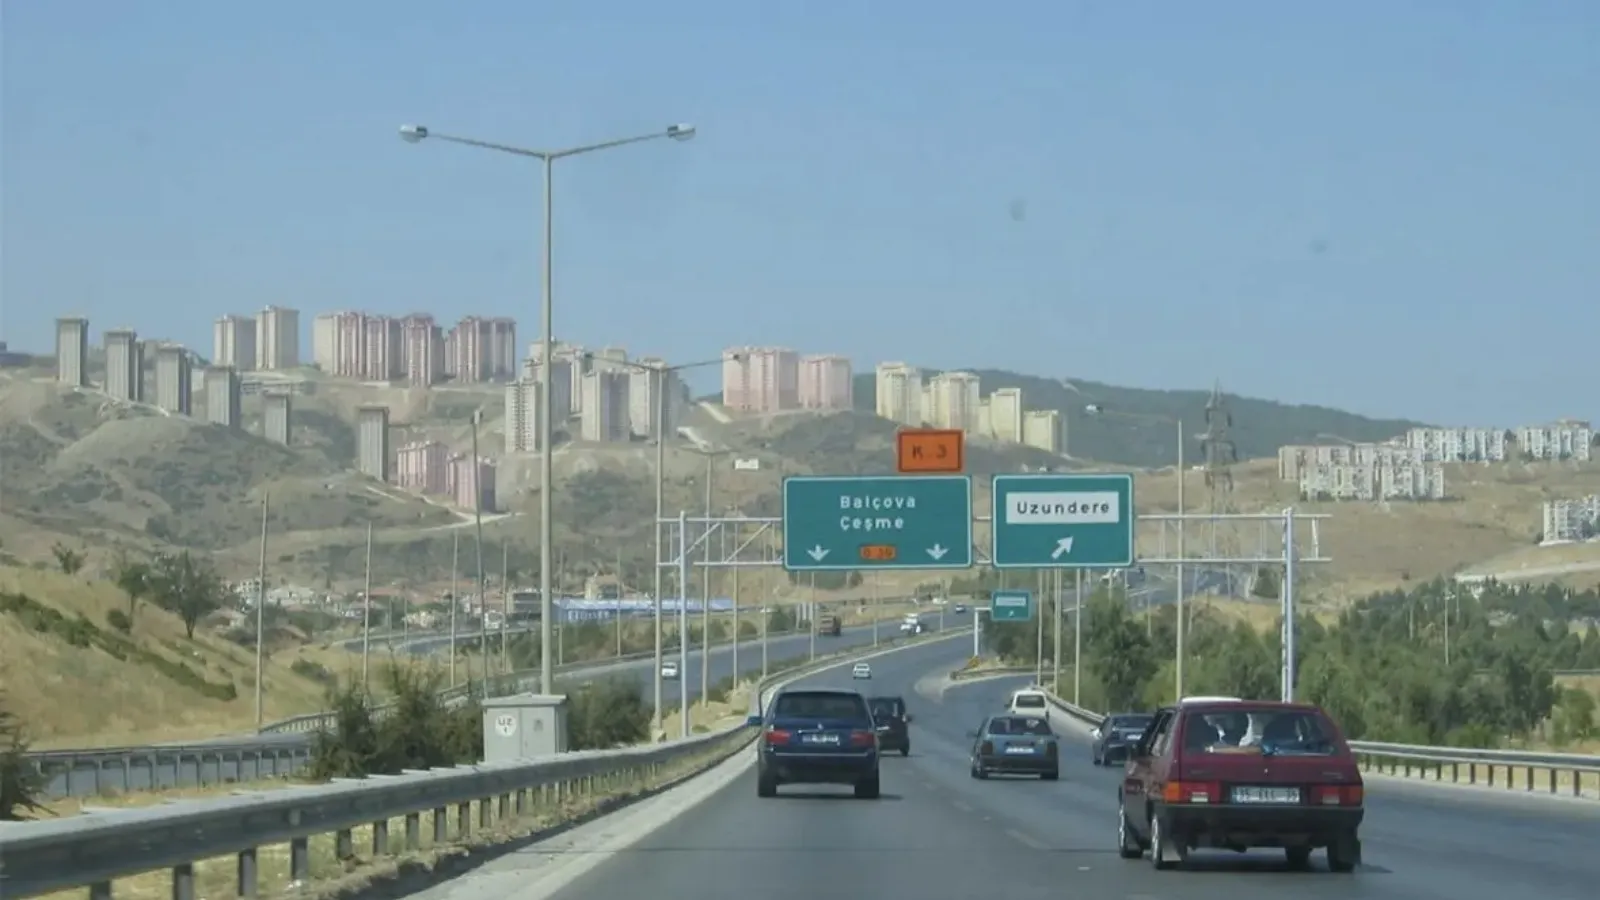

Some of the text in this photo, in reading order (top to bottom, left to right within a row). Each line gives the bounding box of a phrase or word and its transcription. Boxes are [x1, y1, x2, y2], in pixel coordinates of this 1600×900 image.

[840, 495, 916, 510] Balçova
[1016, 500, 1110, 515] Uzundere
[840, 515, 904, 531] Çeşme
